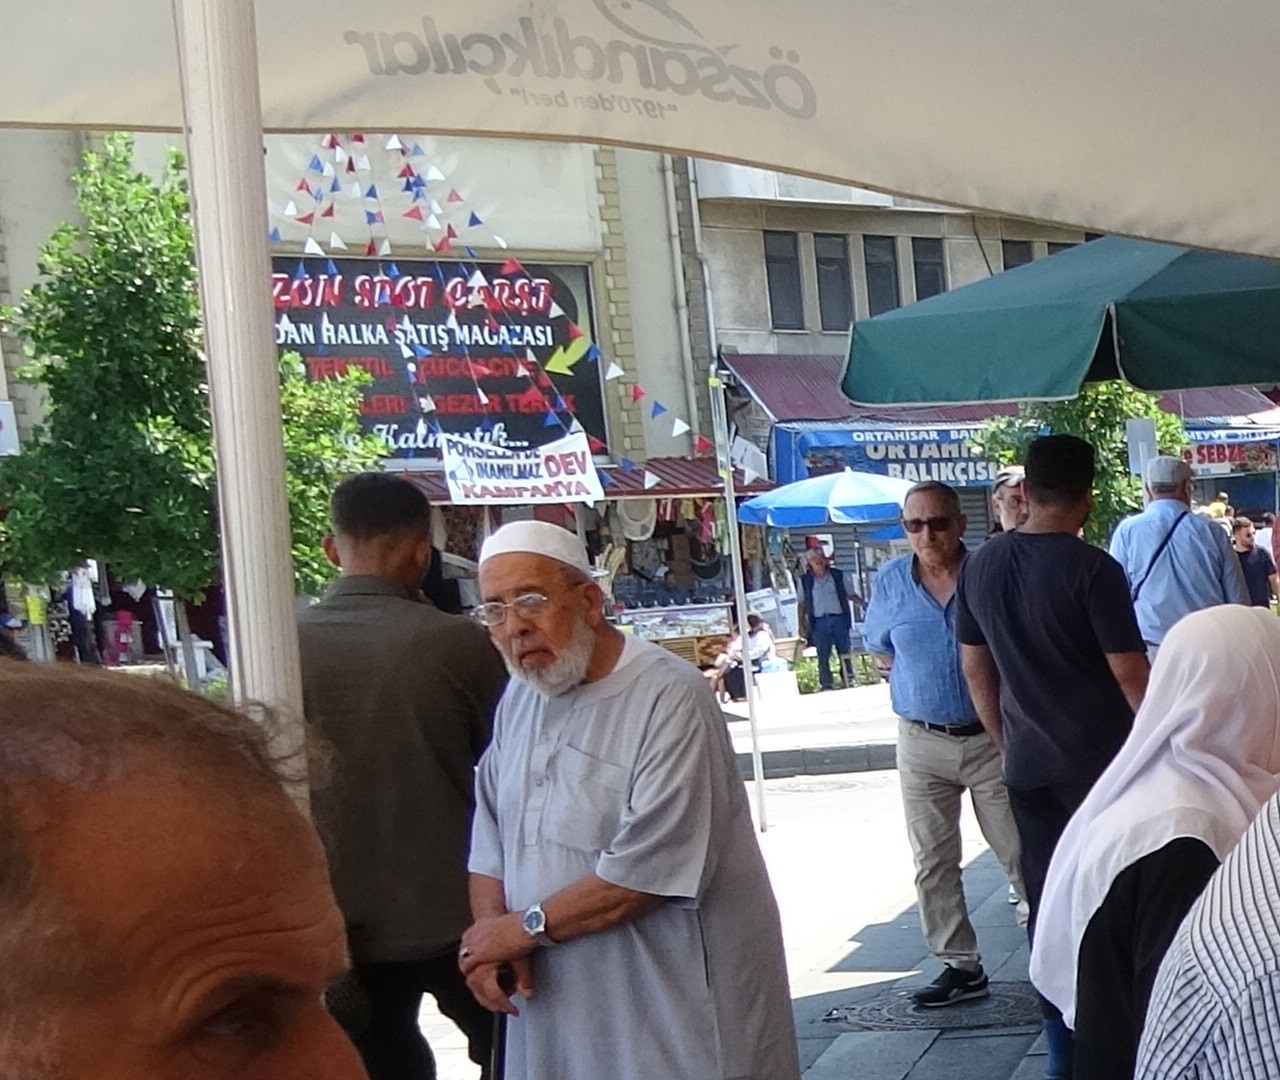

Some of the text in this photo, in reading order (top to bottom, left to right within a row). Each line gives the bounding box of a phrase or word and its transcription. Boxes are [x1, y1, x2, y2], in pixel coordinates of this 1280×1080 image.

[271, 273, 343, 309] ZON
[322, 323, 389, 345] HALKA
[395, 323, 448, 351] SATIŞ
[543, 451, 588, 478] DEV
[1196, 444, 1247, 465] SEBZE
[887, 462, 998, 487] BALIKÇISI
[462, 481, 592, 499] KAMPANYA
